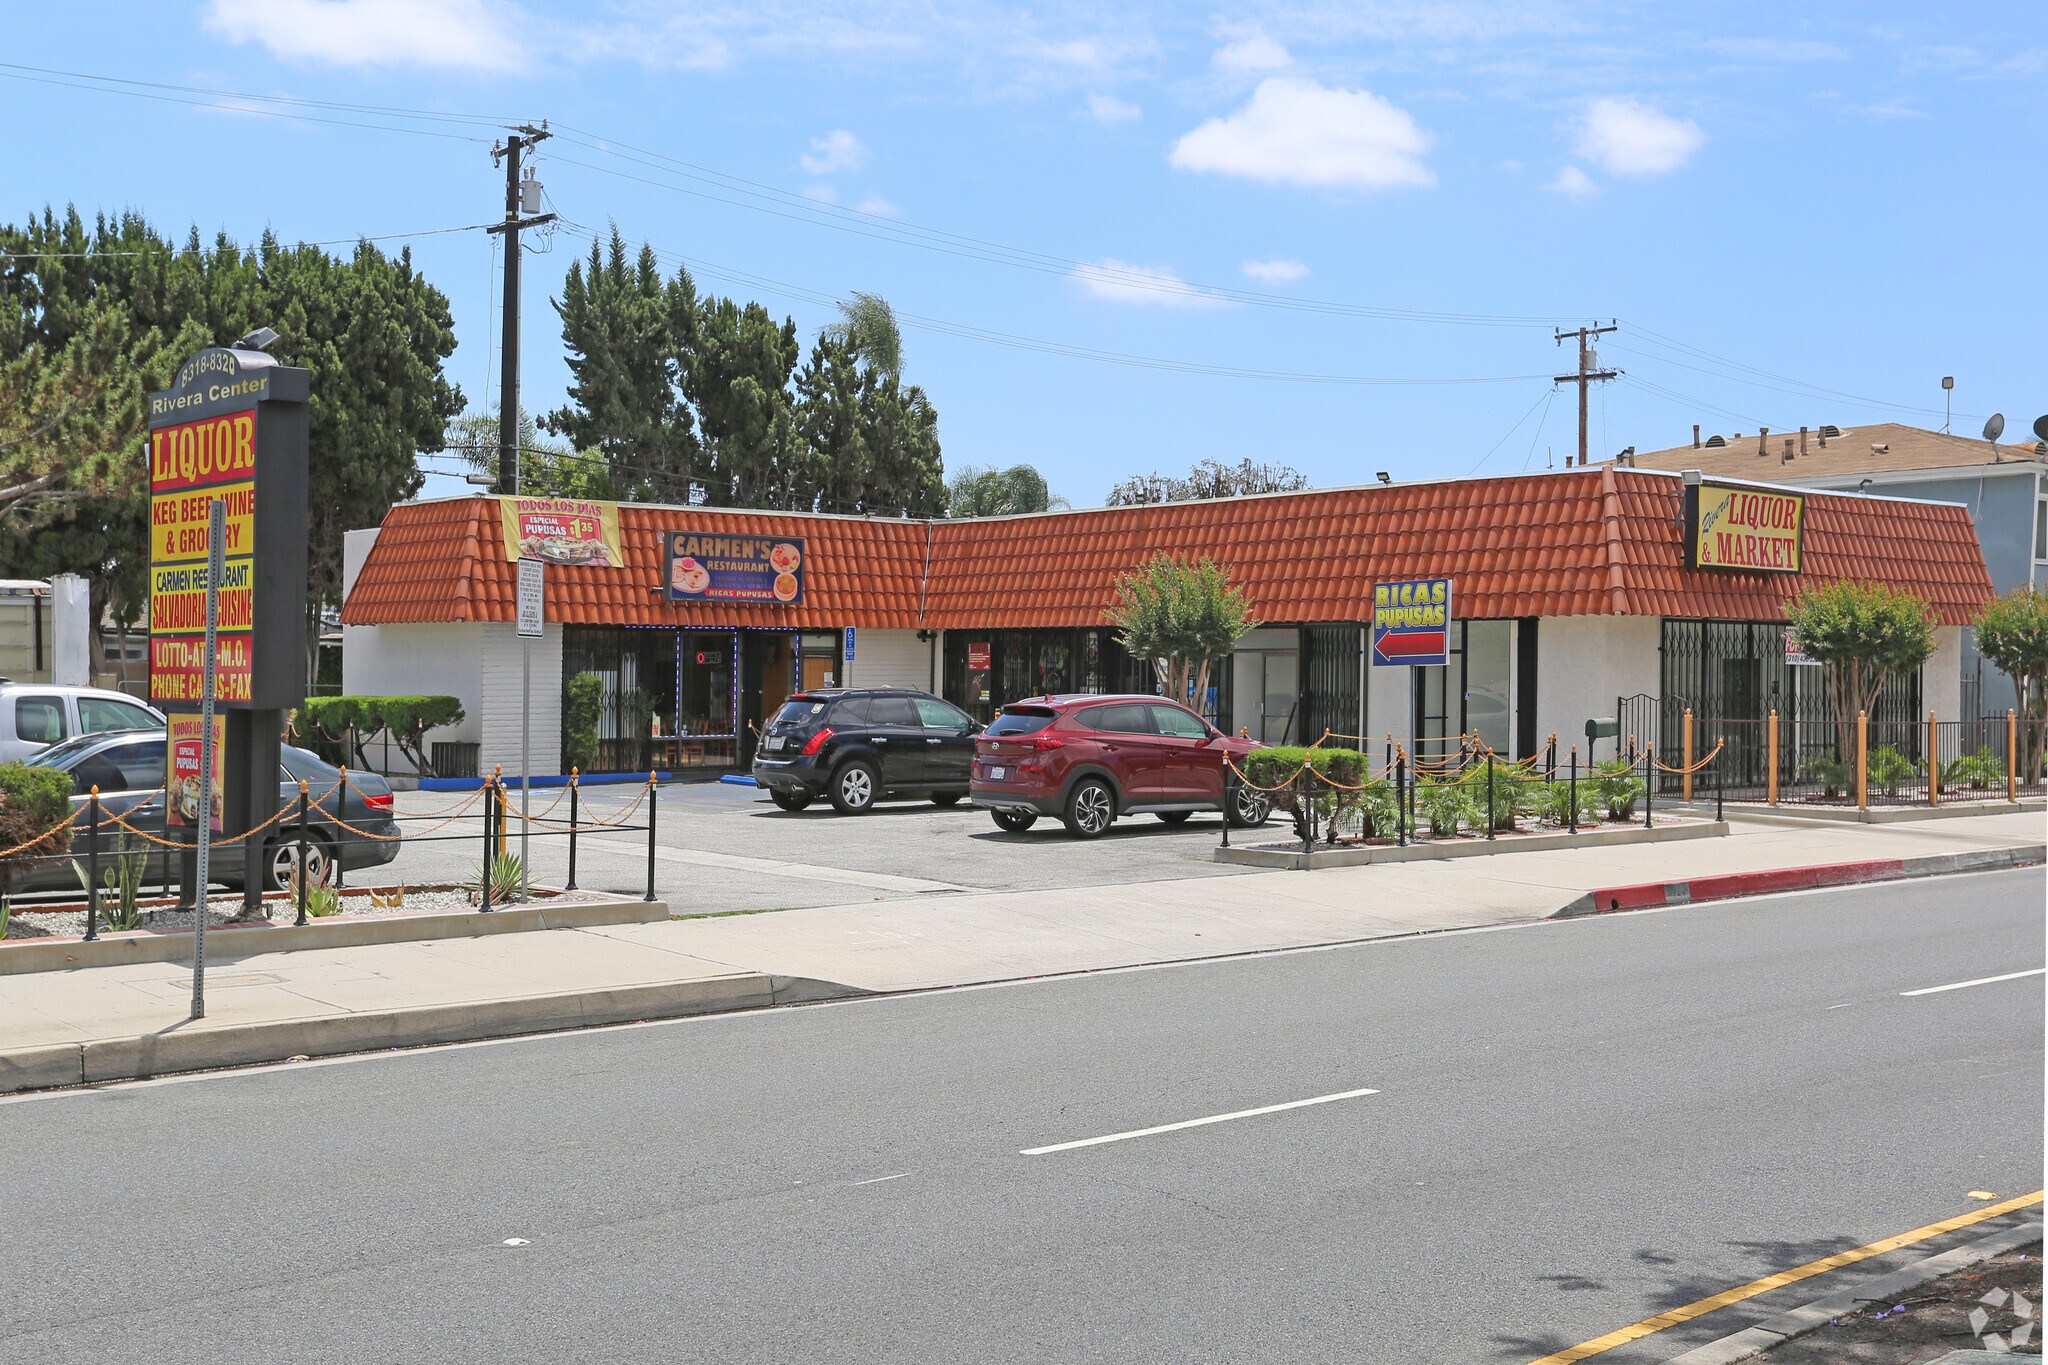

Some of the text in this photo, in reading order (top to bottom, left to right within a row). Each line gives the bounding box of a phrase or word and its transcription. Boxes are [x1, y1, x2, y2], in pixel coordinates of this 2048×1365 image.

[182, 353, 235, 388] 8318-8320
[153, 377, 268, 415] Rivera Center
[152, 416, 255, 483] LIQUOR
[153, 501, 177, 525] KEG
[516, 500, 552, 511] TODOS
[555, 501, 575, 512] LOS
[1728, 493, 1797, 531] LIQUOR
[525, 524, 567, 536] PUPUSAS
[529, 516, 559, 525] ESPECIAL
[166, 522, 241, 554] & GRORY
[673, 535, 771, 560] CARMEN'S
[1702, 532, 1795, 569] & MARKET
[706, 561, 770, 573] RESTAURANT
[156, 569, 190, 592] CARMEN
[709, 589, 773, 599] RICAS PUPUSAS
[1376, 582, 1446, 607] RICAS
[153, 592, 207, 630] SALVADORIA
[1376, 605, 1446, 630] PUPUSAS
[151, 673, 186, 699] PHONE
[176, 757, 199, 770] PUPUSAS
